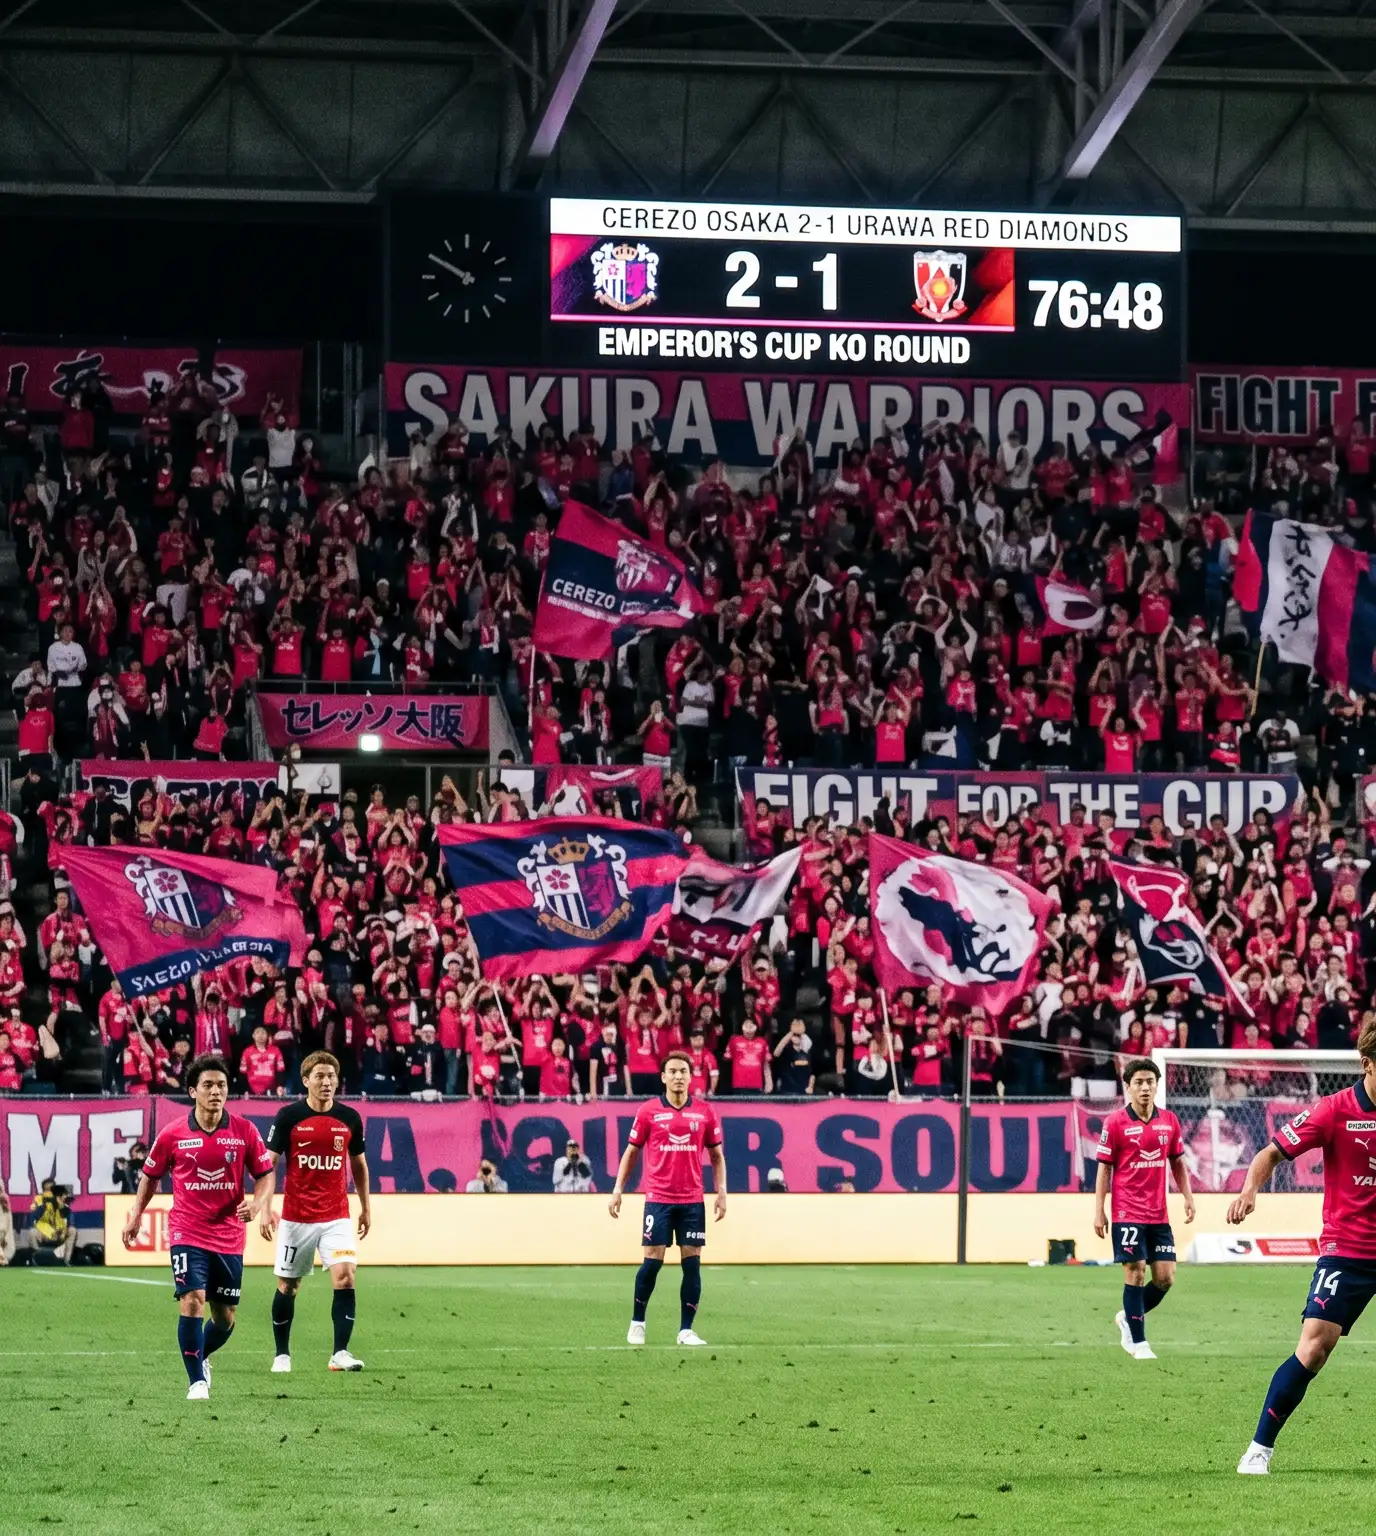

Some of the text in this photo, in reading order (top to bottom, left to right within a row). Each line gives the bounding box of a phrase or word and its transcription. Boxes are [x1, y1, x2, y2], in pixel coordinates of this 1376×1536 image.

[602, 206, 1129, 243] CEREZO OSAKA 2-1 URAWA RED DIAMONDS
[1028, 279, 1164, 331] 76:48
[598, 327, 971, 364] EMPEROR'S CUP KO ROUND
[404, 371, 1146, 459] SAKURA WARRIORS
[1196, 373, 1342, 436] FIGHT
[551, 578, 617, 611] CEREZO
[280, 699, 465, 748] セレッソ大阪
[754, 773, 938, 832] FIGHT
[1050, 782, 1140, 829] THE
[1163, 780, 1287, 839] CUP
[297, 1154, 343, 1170] POLUS
[645, 1214, 655, 1233] 9
[1121, 1227, 1139, 1246] 22
[1313, 1268, 1342, 1297] 14
